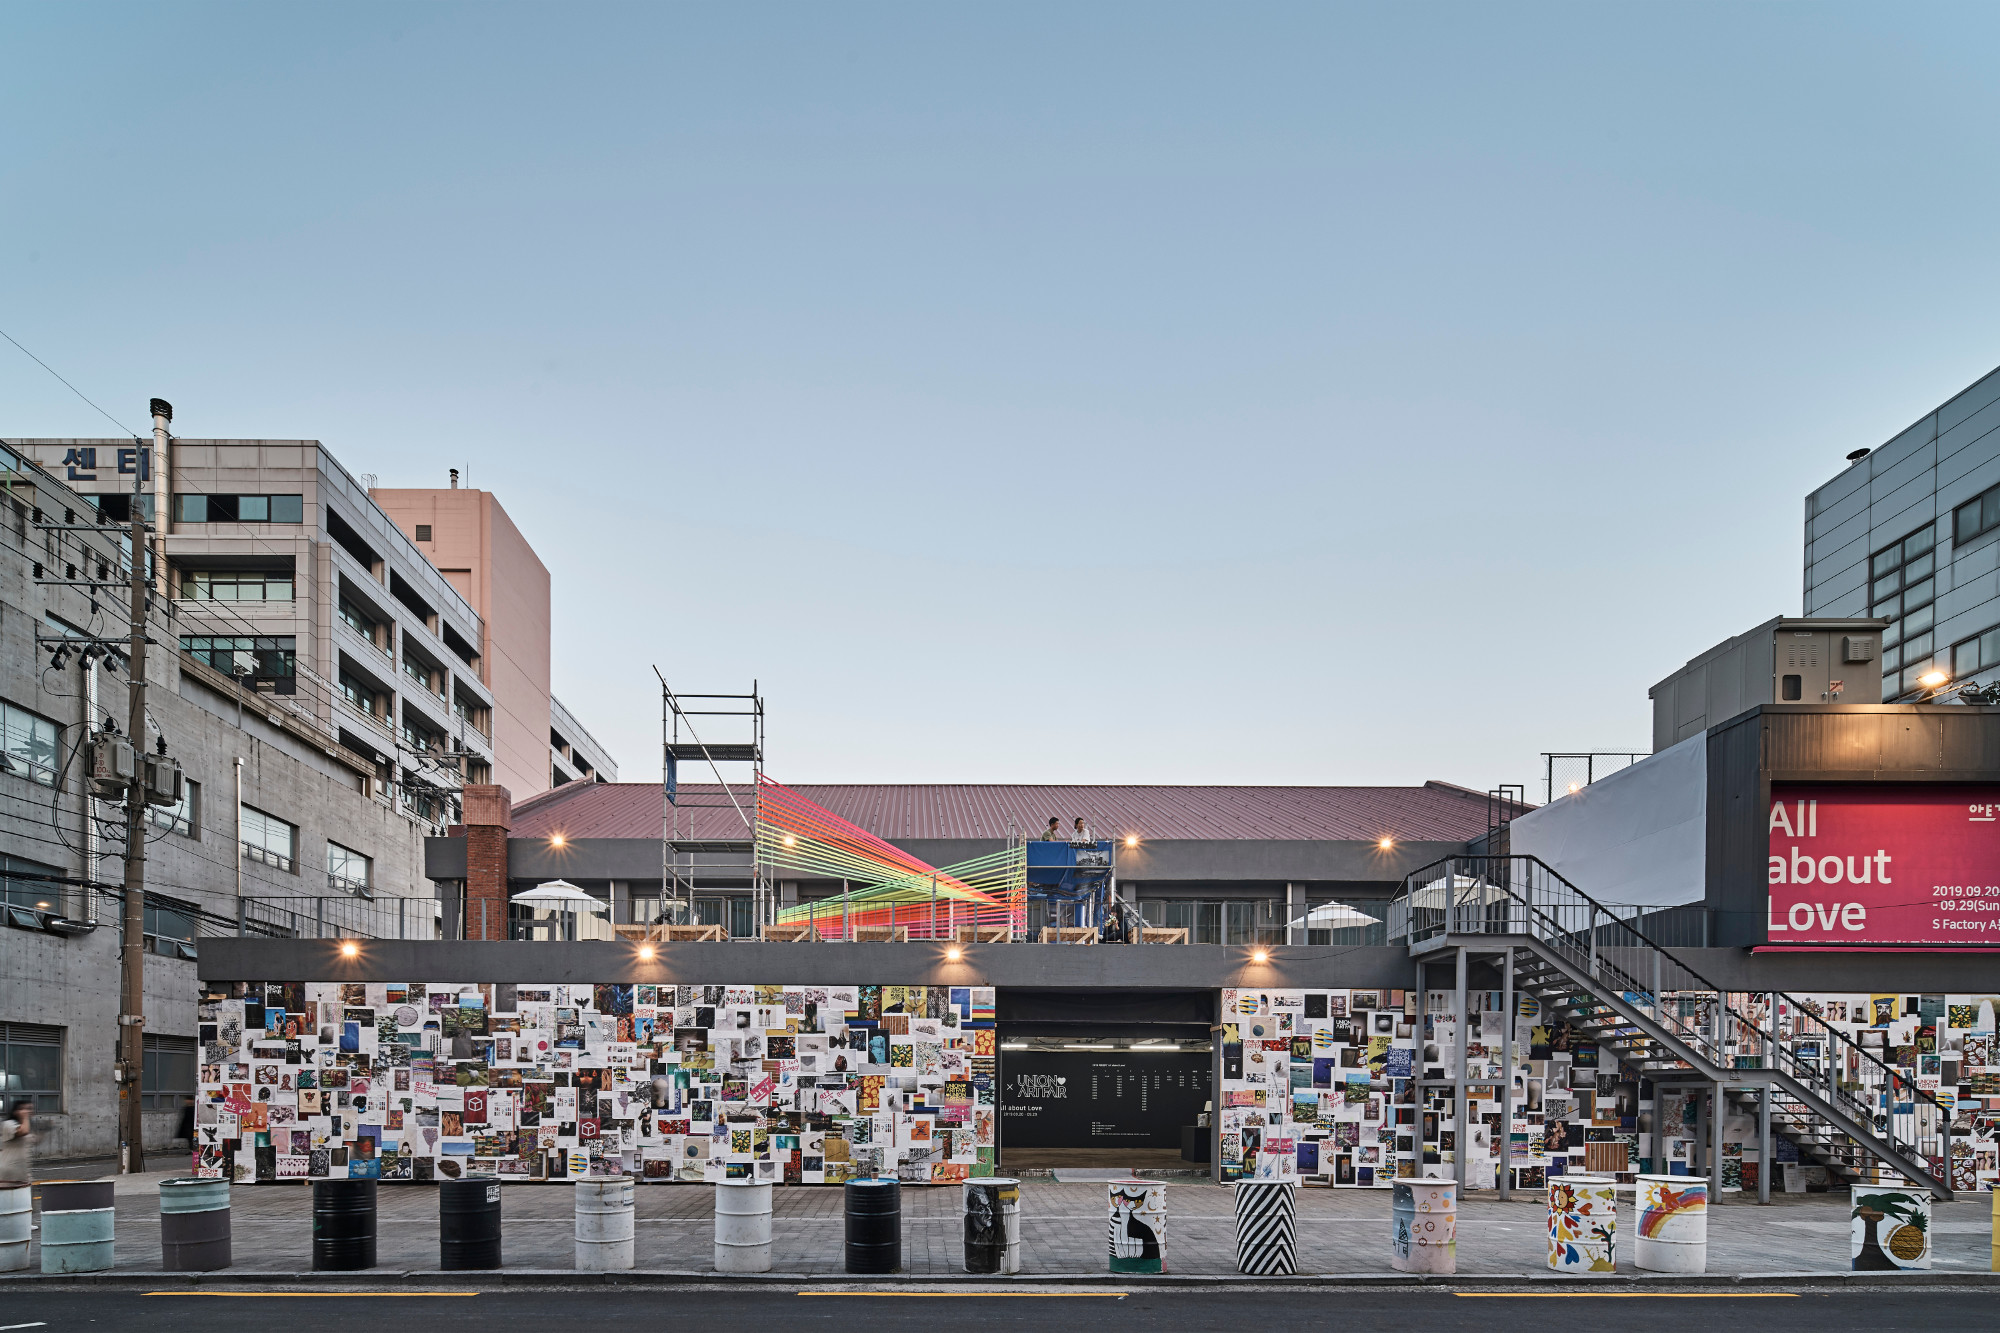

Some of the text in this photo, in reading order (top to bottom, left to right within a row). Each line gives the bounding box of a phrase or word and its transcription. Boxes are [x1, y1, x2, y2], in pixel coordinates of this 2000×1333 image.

[1770, 800, 1817, 837] All
[1769, 846, 1892, 885] about
[1933, 885, 1999, 898] 2019.09.20
[1768, 895, 1867, 932] Love
[1933, 919, 1940, 930] S
[1943, 919, 1986, 933] Factory
[1017, 1075, 1057, 1086] UNION
